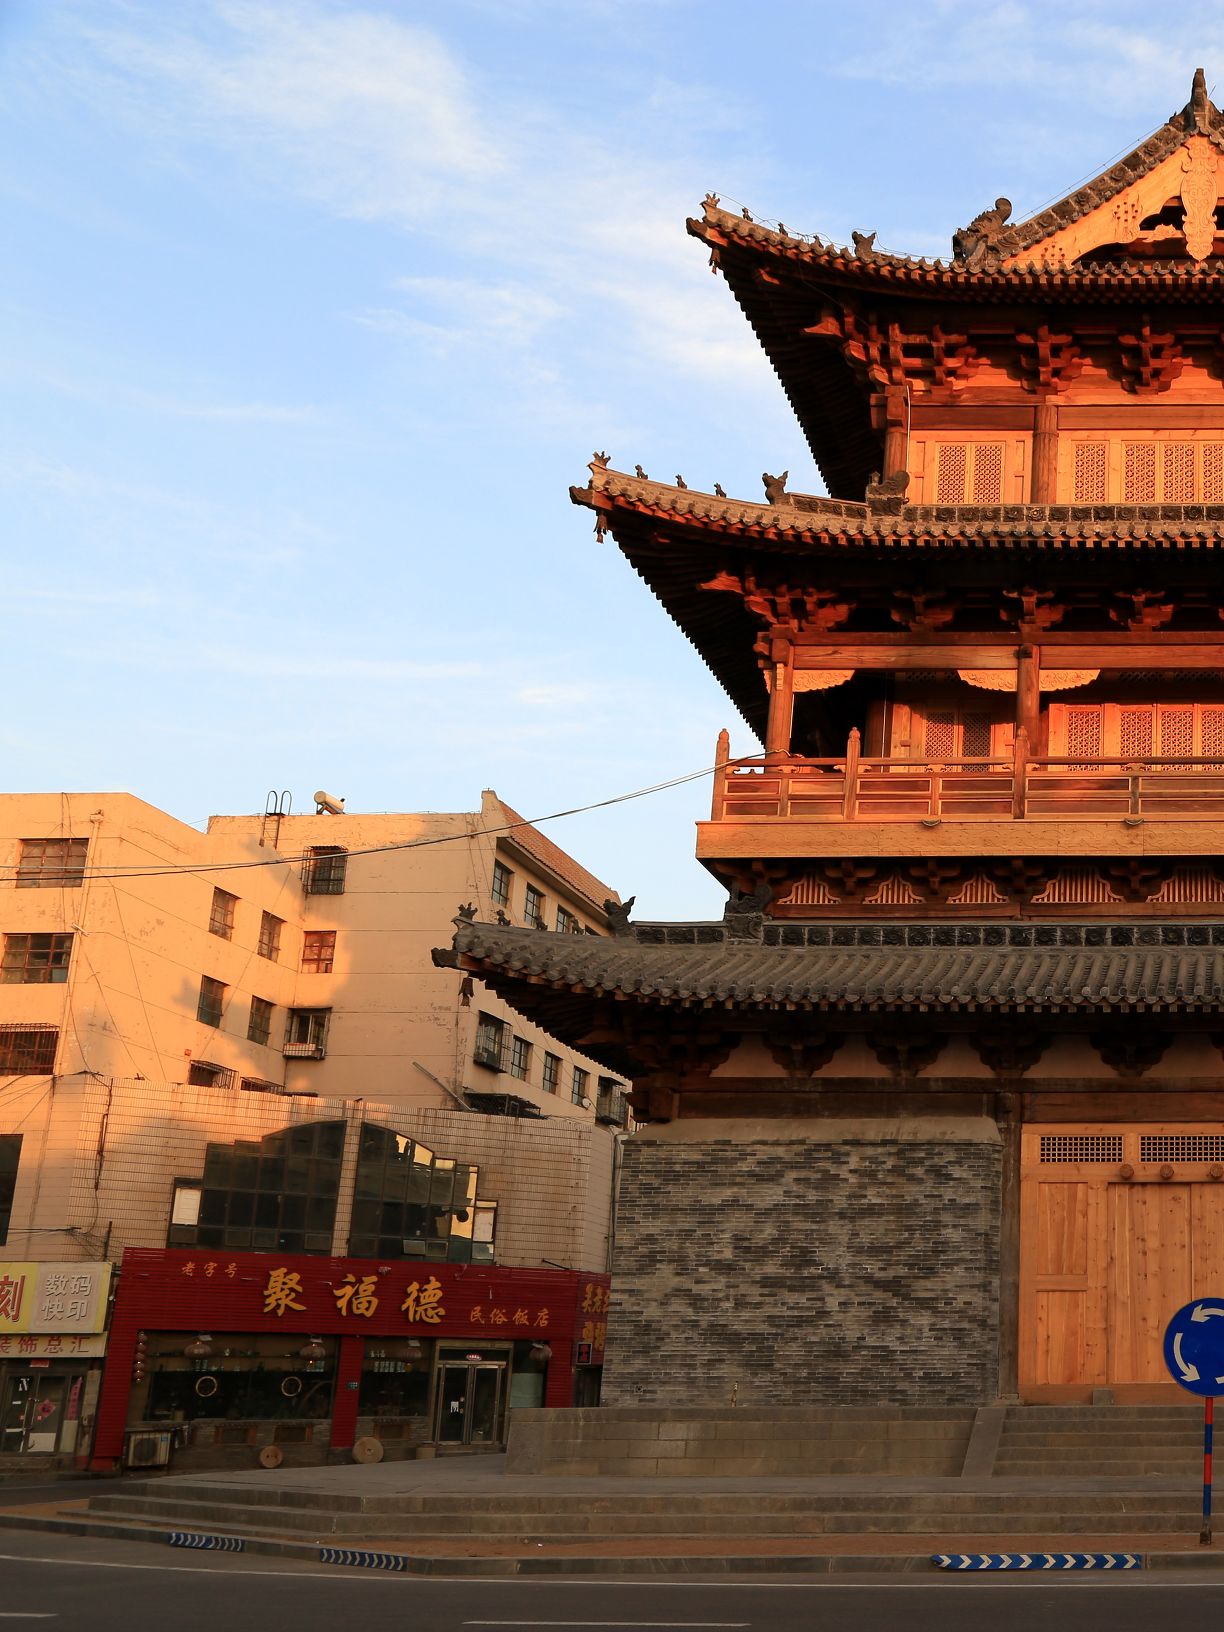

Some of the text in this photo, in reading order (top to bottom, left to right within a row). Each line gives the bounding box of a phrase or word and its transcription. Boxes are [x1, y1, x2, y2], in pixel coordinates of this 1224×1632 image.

[182, 1261, 238, 1278] 老字号
[45, 1274, 93, 1297] 数码
[263, 1267, 446, 1324] 聚福德
[41, 1299, 89, 1321] 快印
[470, 1306, 550, 1327] 民俗饭店
